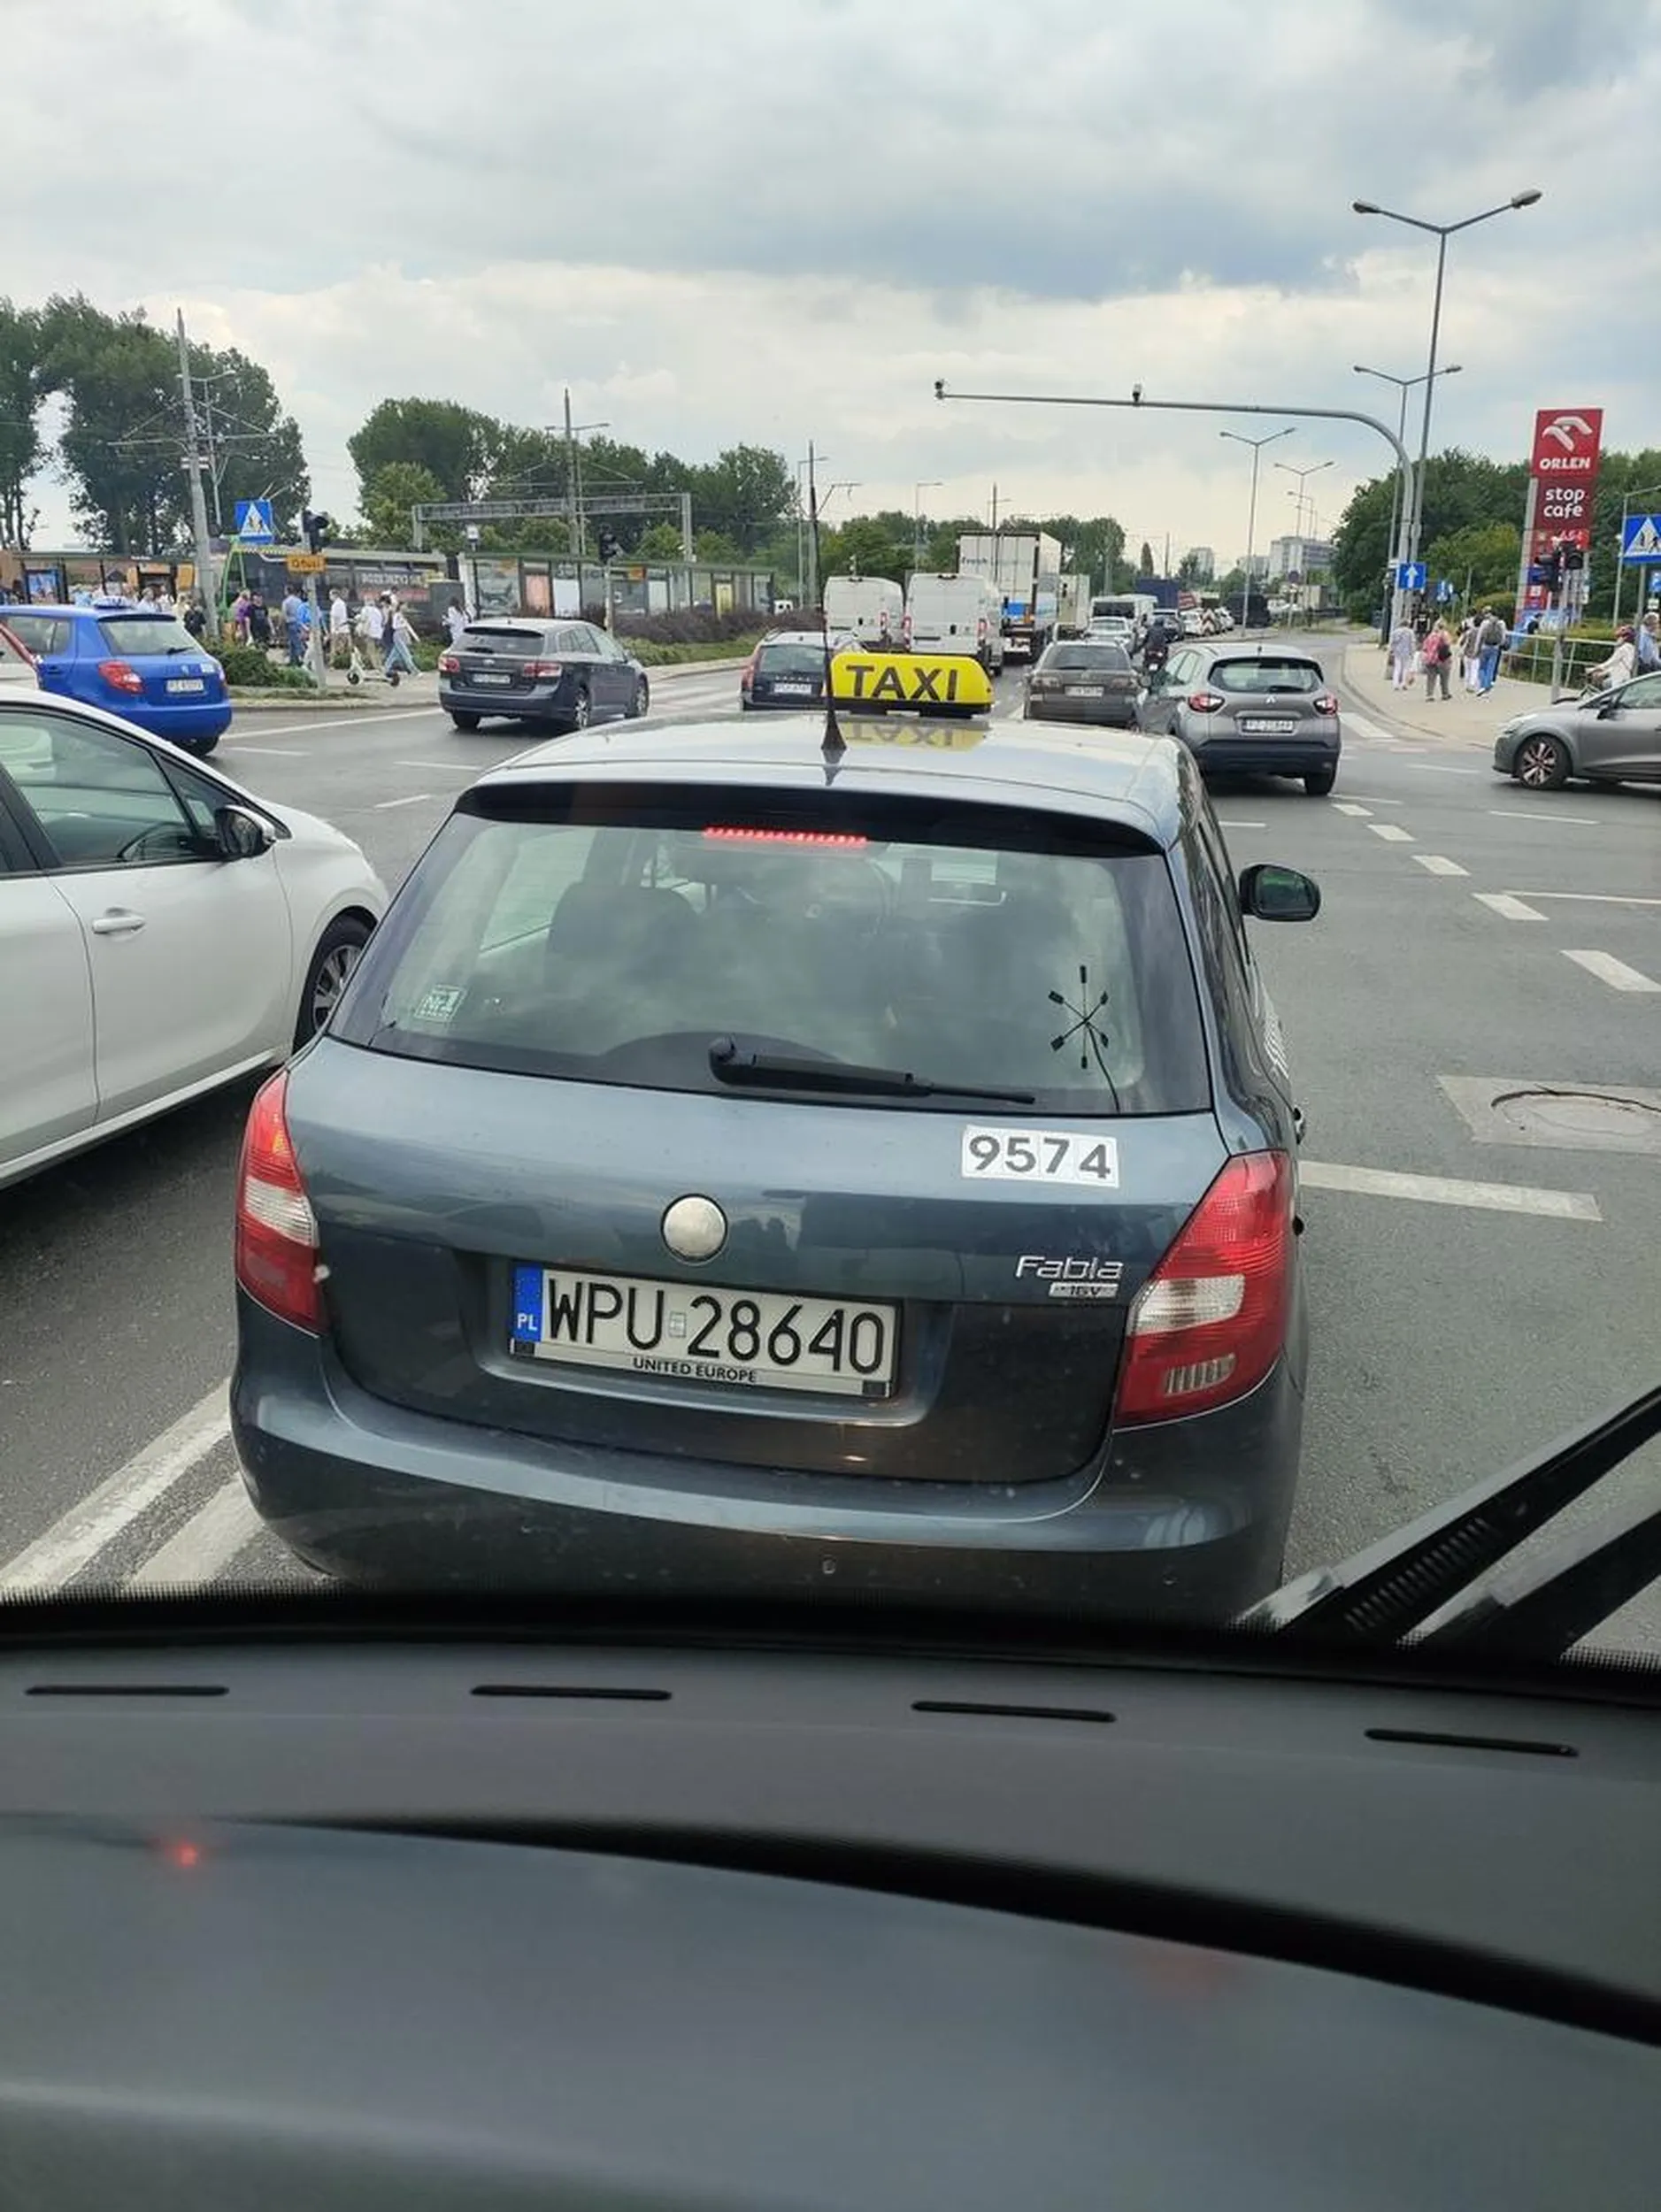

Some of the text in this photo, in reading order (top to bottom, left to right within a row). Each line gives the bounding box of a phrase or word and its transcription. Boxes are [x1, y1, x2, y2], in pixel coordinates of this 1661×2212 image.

[1540, 457, 1590, 470] ORLEN
[1546, 488, 1585, 503] stop
[1543, 503, 1583, 518] cafe
[846, 665, 957, 701] TAXI
[969, 1134, 1111, 1179] 9574
[1016, 1256, 1123, 1279] Fabia
[517, 1314, 538, 1332] PL
[549, 1279, 884, 1374] WPU 28640
[633, 1357, 757, 1383] UNITED EUROPE
